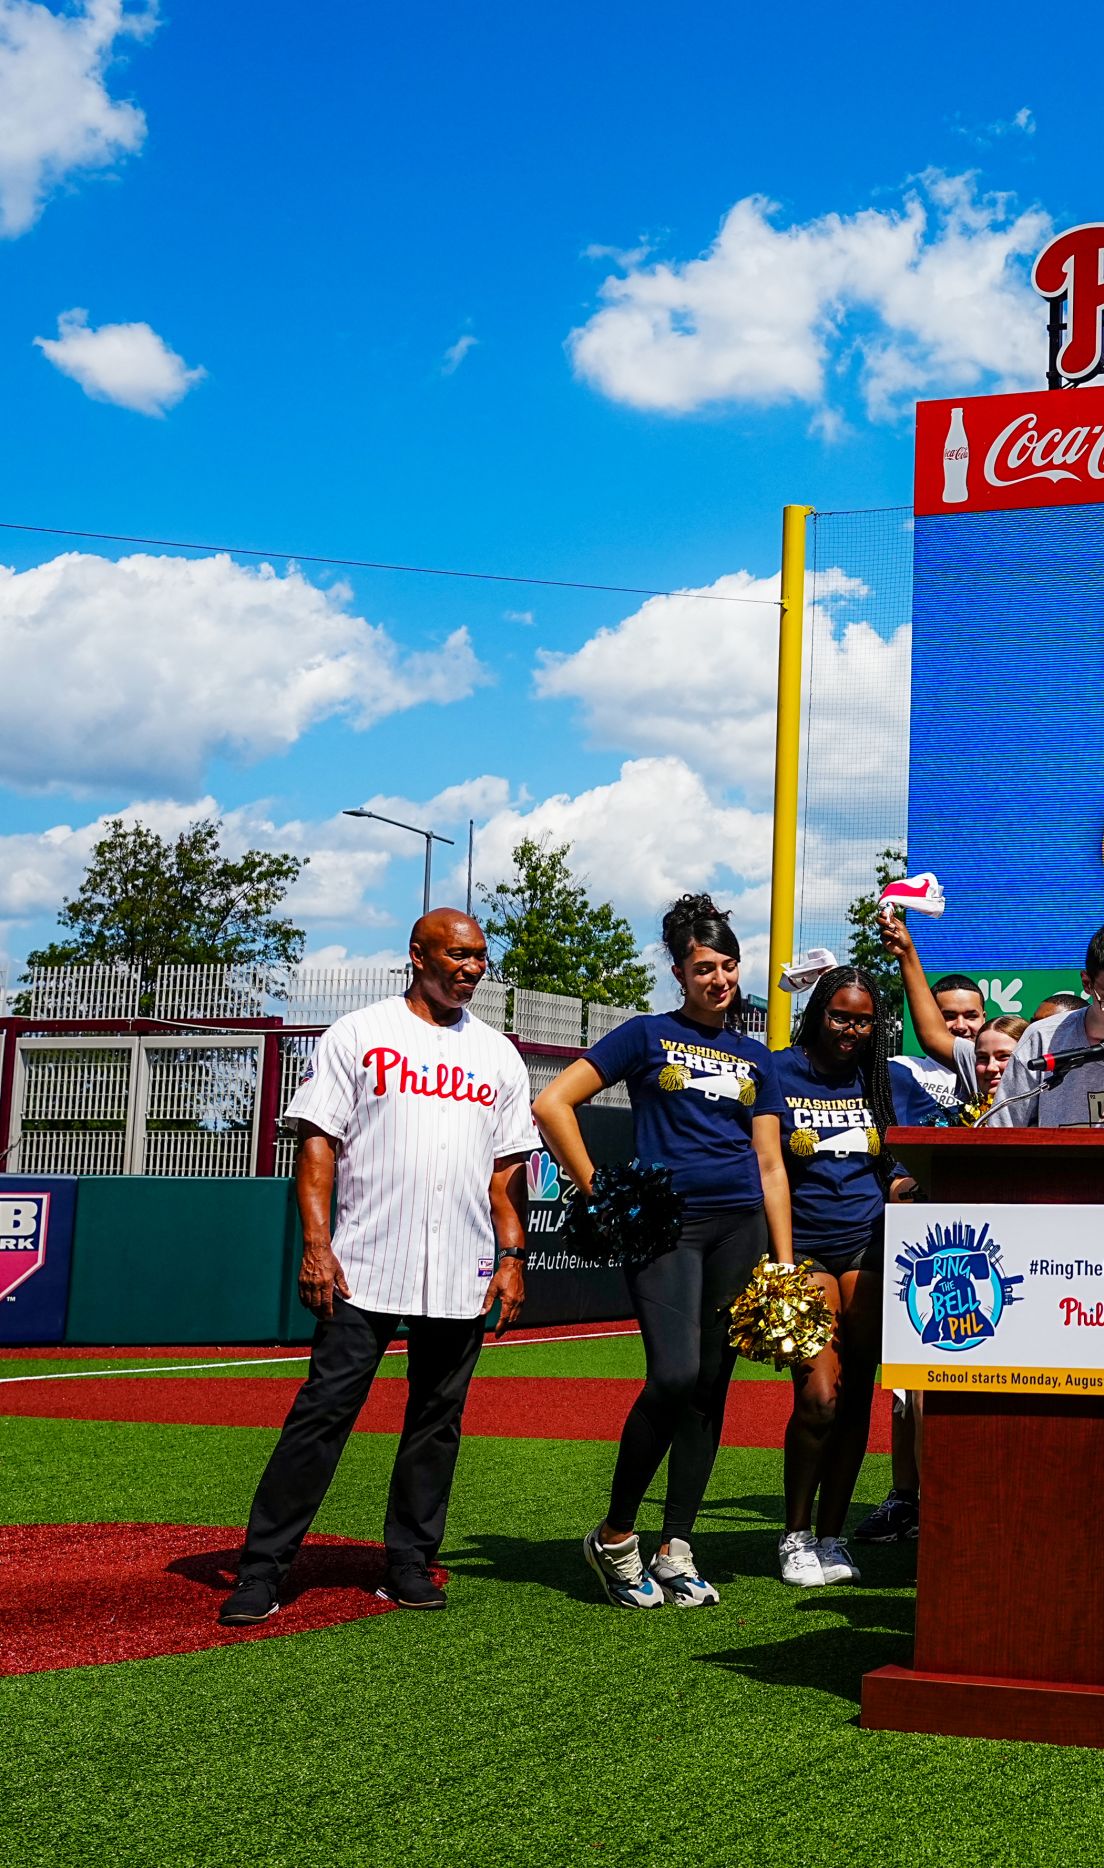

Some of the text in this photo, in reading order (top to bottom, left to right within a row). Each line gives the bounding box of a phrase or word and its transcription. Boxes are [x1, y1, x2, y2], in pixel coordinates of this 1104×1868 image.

[660, 1039, 758, 1068] WASHINGT
[666, 1050, 752, 1080] CHEER
[363, 1047, 498, 1107] Phillie
[527, 1210, 566, 1233] HILA
[933, 1256, 970, 1279] RING
[938, 1281, 955, 1292] THE
[930, 1287, 980, 1322] BELL
[948, 1312, 983, 1339] PHL
[927, 1370, 968, 1383] School
[972, 1373, 1007, 1385] starts
[1011, 1373, 1061, 1388] Monday,
